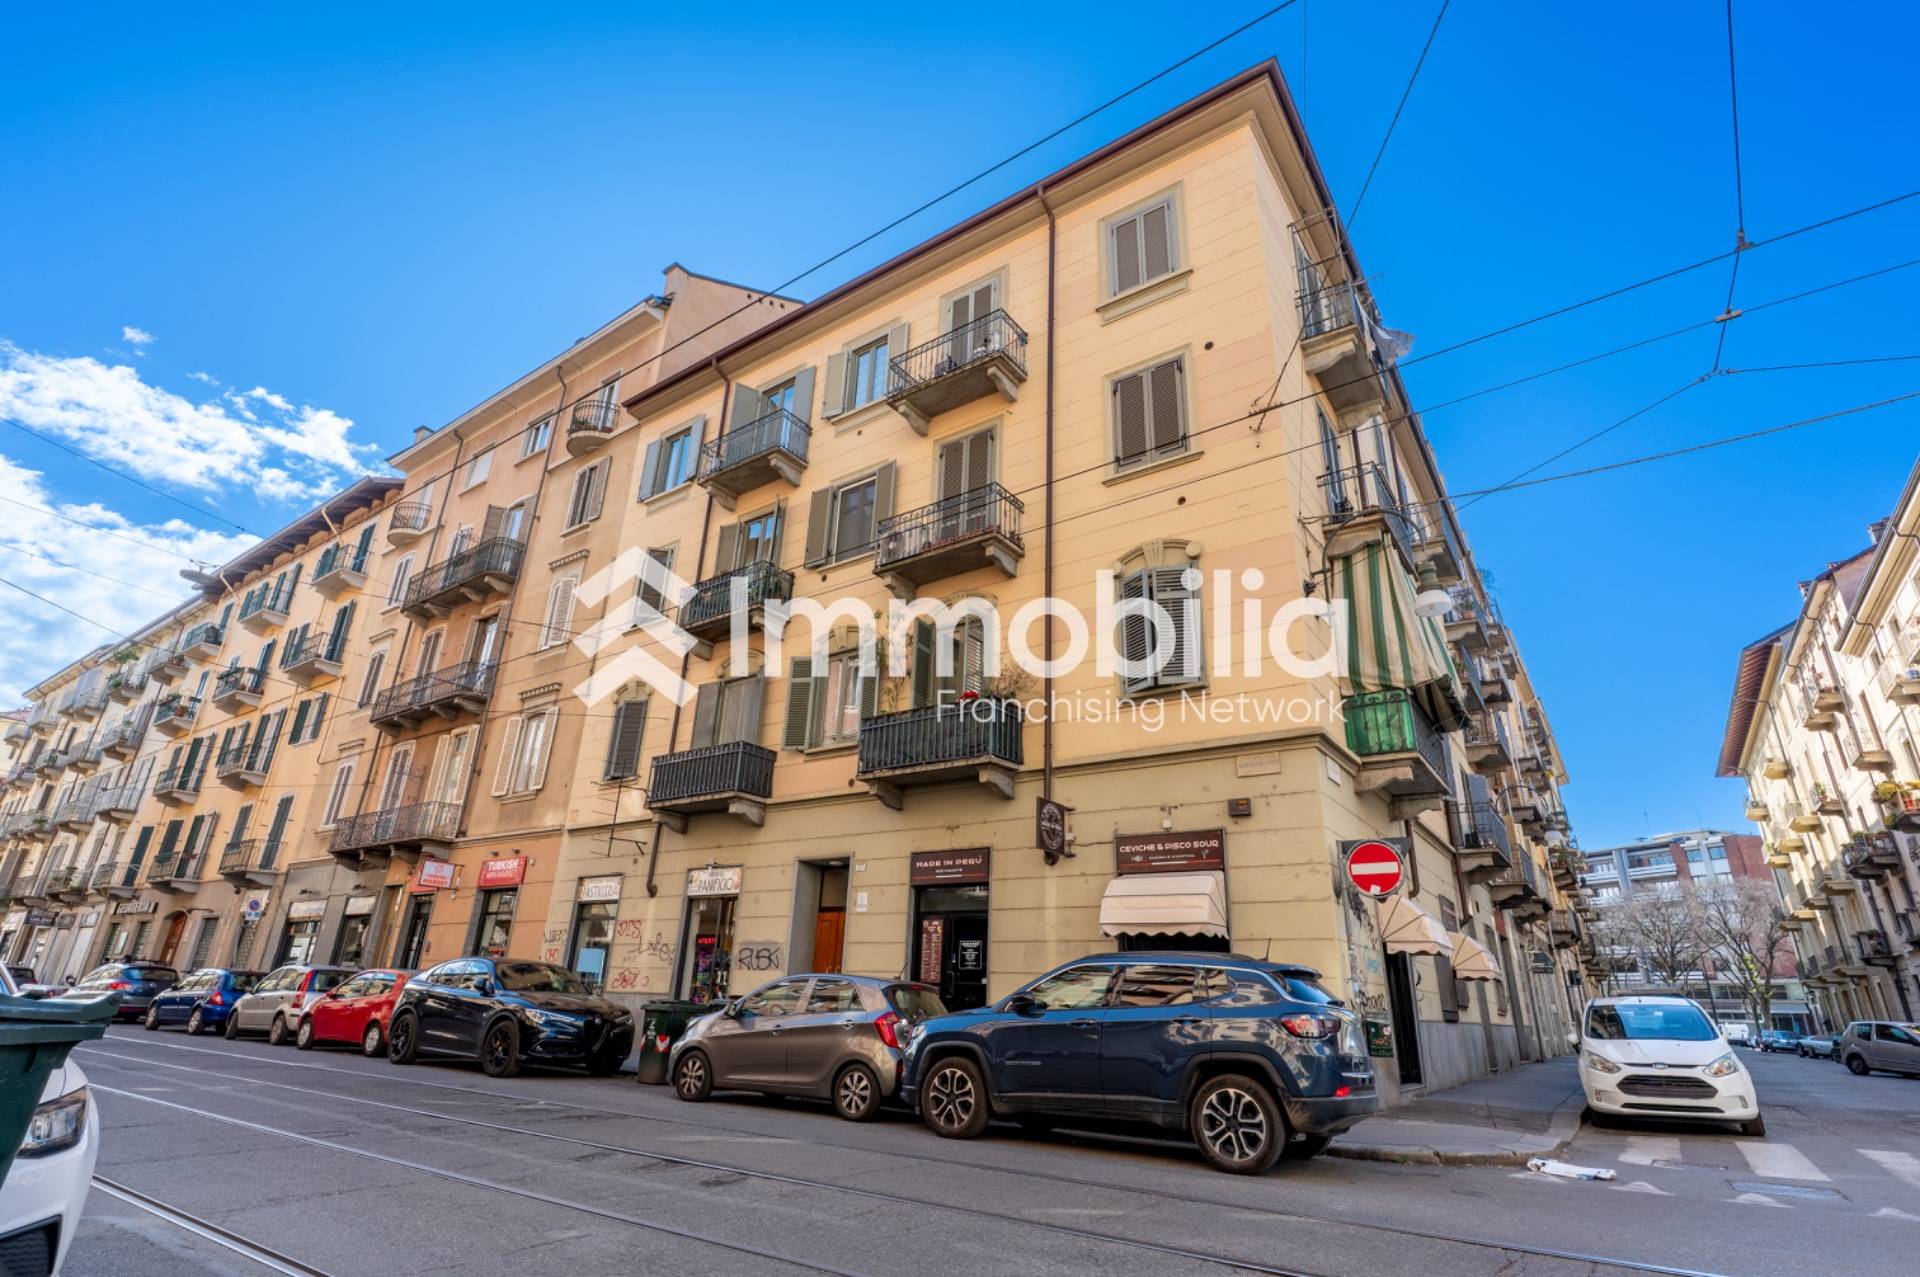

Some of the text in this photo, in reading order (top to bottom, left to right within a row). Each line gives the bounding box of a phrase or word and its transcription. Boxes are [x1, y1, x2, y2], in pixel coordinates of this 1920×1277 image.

[1119, 843, 1156, 853] CEVICHE
[1193, 839, 1219, 849] SOUR
[488, 858, 519, 871] TURKISH
[916, 860, 942, 869] MADE
[955, 855, 983, 865] PERÚ
[698, 877, 734, 891] PANIFICIO
